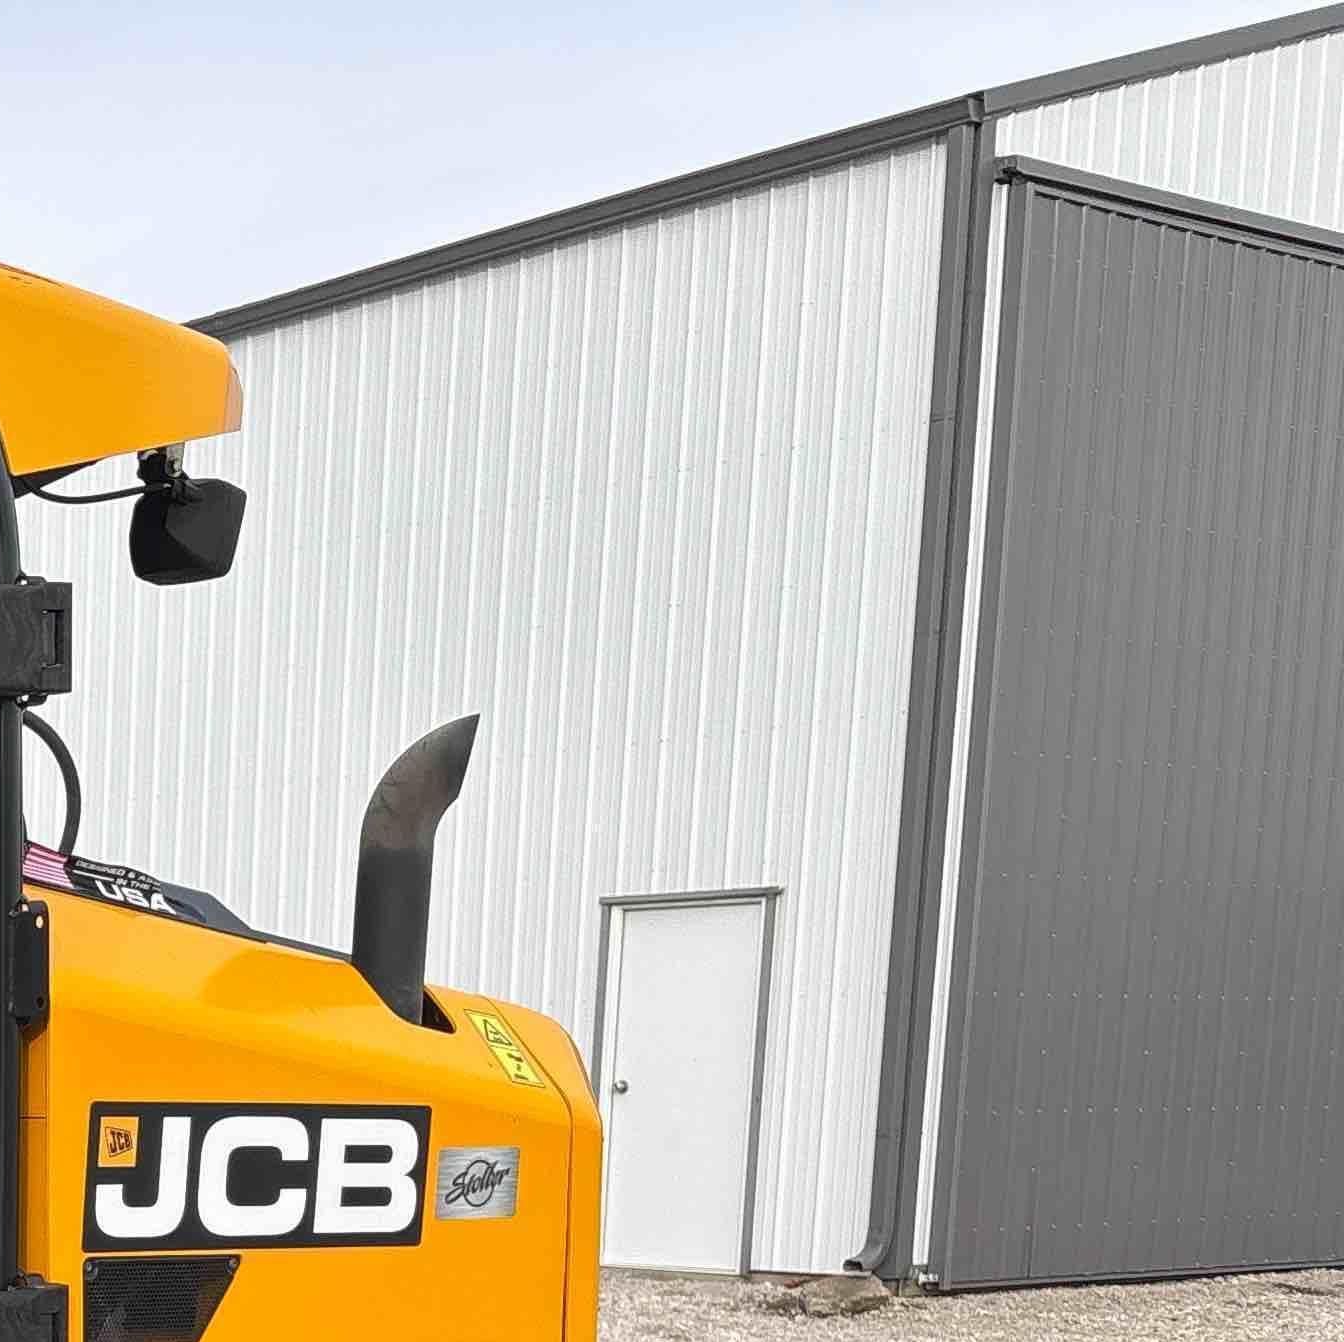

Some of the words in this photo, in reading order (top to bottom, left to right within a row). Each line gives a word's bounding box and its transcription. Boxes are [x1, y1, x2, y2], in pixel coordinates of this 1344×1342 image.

[95, 880, 177, 915] USA
[115, 877, 129, 887] IN
[130, 880, 152, 891] THE
[107, 1129, 133, 1154] JCB
[95, 1115, 419, 1239] JCB
